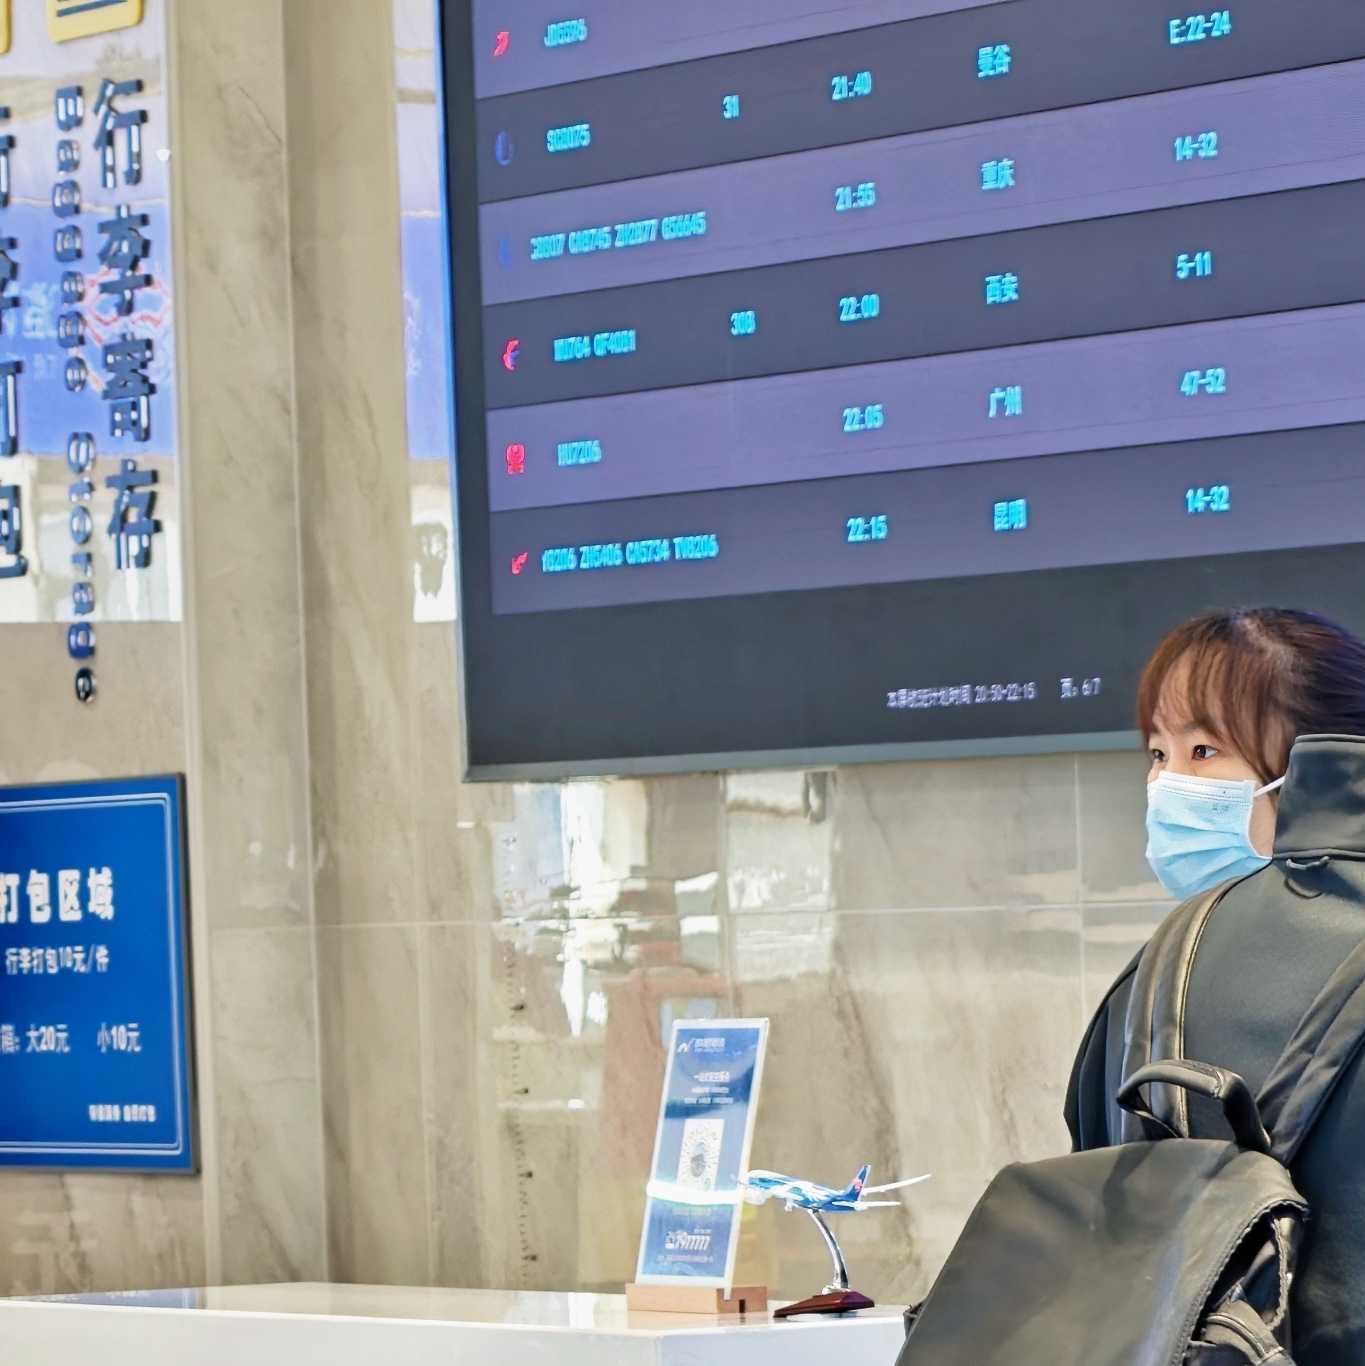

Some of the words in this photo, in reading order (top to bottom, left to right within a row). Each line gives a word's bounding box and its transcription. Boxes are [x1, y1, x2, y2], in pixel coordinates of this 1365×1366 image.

[1170, 11, 1231, 44] E:22-24
[978, 44, 1011, 78] 曼谷
[831, 71, 872, 100] 21:40
[1174, 131, 1217, 161] 14-32
[981, 158, 1015, 190] 重庆
[835, 183, 875, 211] 21:55
[1176, 251, 1212, 279] 5-11
[985, 272, 1019, 305] 西安
[839, 294, 880, 322] 22:00
[93, 78, 162, 570] 行李寄存
[1181, 367, 1226, 396] 47-52
[988, 385, 1022, 418] 广州
[843, 404, 884, 431] 22:05
[1186, 485, 1230, 513] 14-32
[847, 514, 887, 542] 22:15
[993, 499, 1027, 531] 昆明
[0, 866, 115, 924] 打包区域
[26, 1023, 71, 1053] 大20元
[97, 1022, 142, 1054] 小10元
